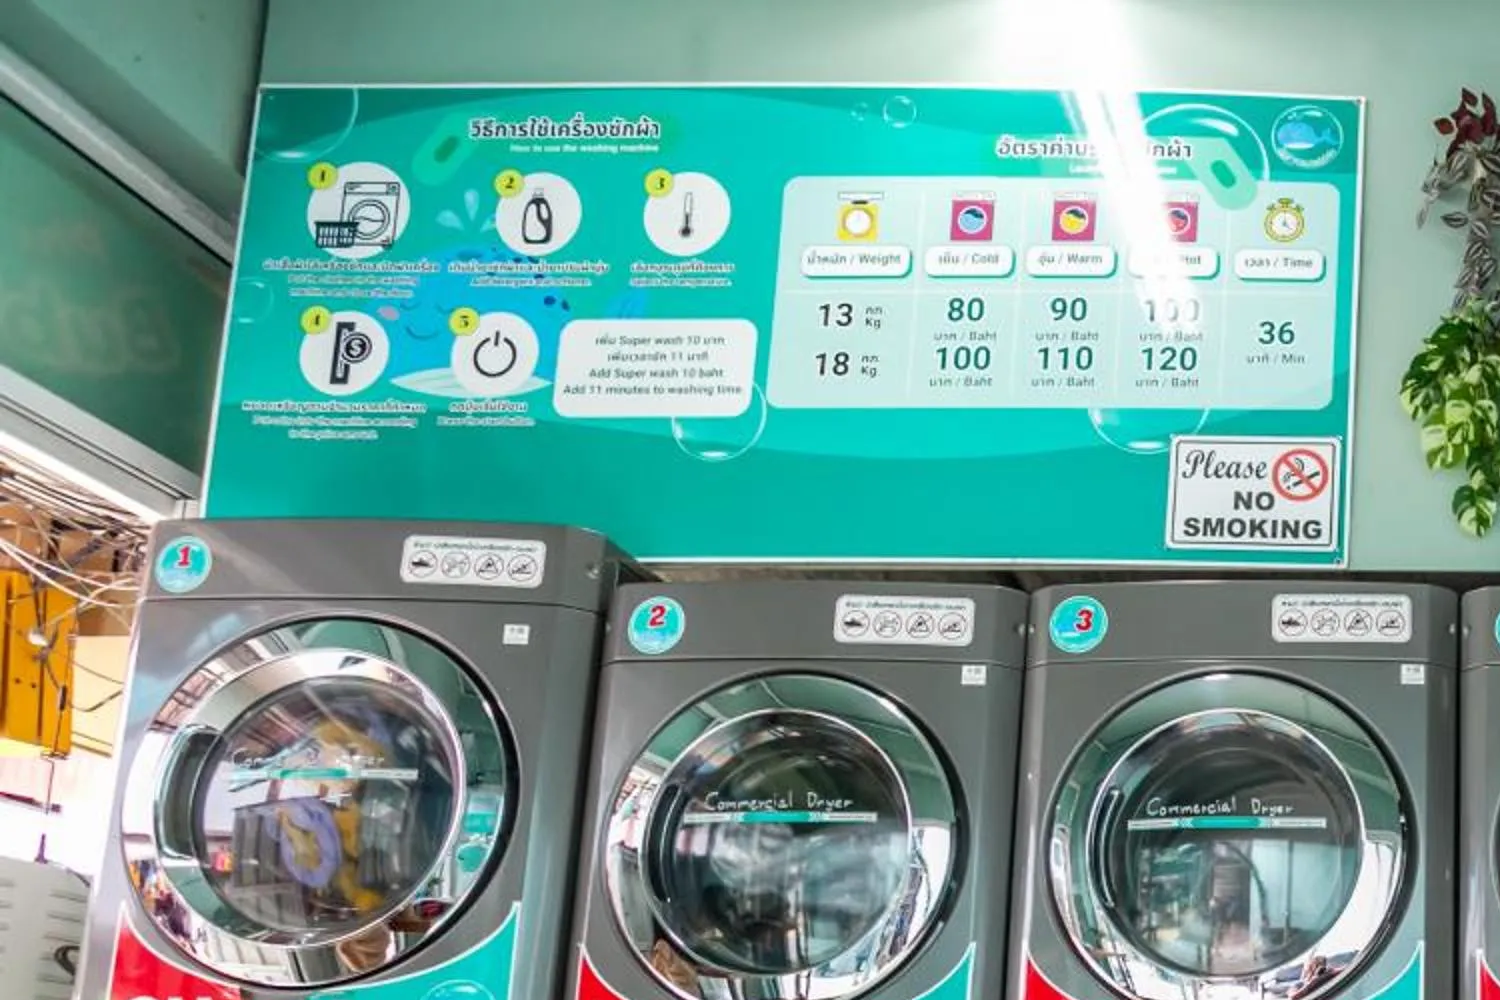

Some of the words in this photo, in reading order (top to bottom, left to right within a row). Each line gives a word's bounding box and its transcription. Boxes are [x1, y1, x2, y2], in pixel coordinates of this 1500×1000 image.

[470, 112, 660, 139] วิธีการใช้เครื่องซักผ้า
[859, 253, 901, 266] Weight
[971, 253, 1000, 264] Cold
[1066, 254, 1103, 264] Warm
[1282, 257, 1313, 268] Time
[818, 303, 854, 327] 13
[947, 297, 985, 321] 80
[1051, 297, 1087, 321] 90
[865, 317, 882, 329] Kg
[1258, 321, 1295, 345] 36
[969, 331, 997, 342] Baht
[815, 352, 850, 376] 18
[936, 346, 991, 371] 100
[1038, 346, 1094, 371] 110
[1142, 346, 1198, 371] 120
[1281, 354, 1305, 364] Min
[589, 369, 610, 378] Add
[614, 369, 645, 380] Super
[650, 369, 678, 378] wash
[861, 366, 877, 378] Kg
[964, 376, 993, 387] Baht
[1066, 376, 1095, 387] Baht
[563, 385, 586, 394] Add
[605, 385, 650, 395] minutes
[653, 385, 664, 394] to
[667, 385, 714, 396] washing
[717, 385, 742, 394] time
[1171, 377, 1199, 388] Baht
[1182, 449, 1268, 479] Please
[1233, 491, 1275, 511] NO
[1183, 517, 1322, 539] SMOKING
[177, 547, 192, 567] 1
[648, 606, 666, 627] 2
[1075, 609, 1093, 632] 3
[704, 788, 793, 811] Commercial
[806, 789, 854, 812] Dryer
[1146, 795, 1238, 817] Commercial
[1251, 797, 1295, 818] Dryer
